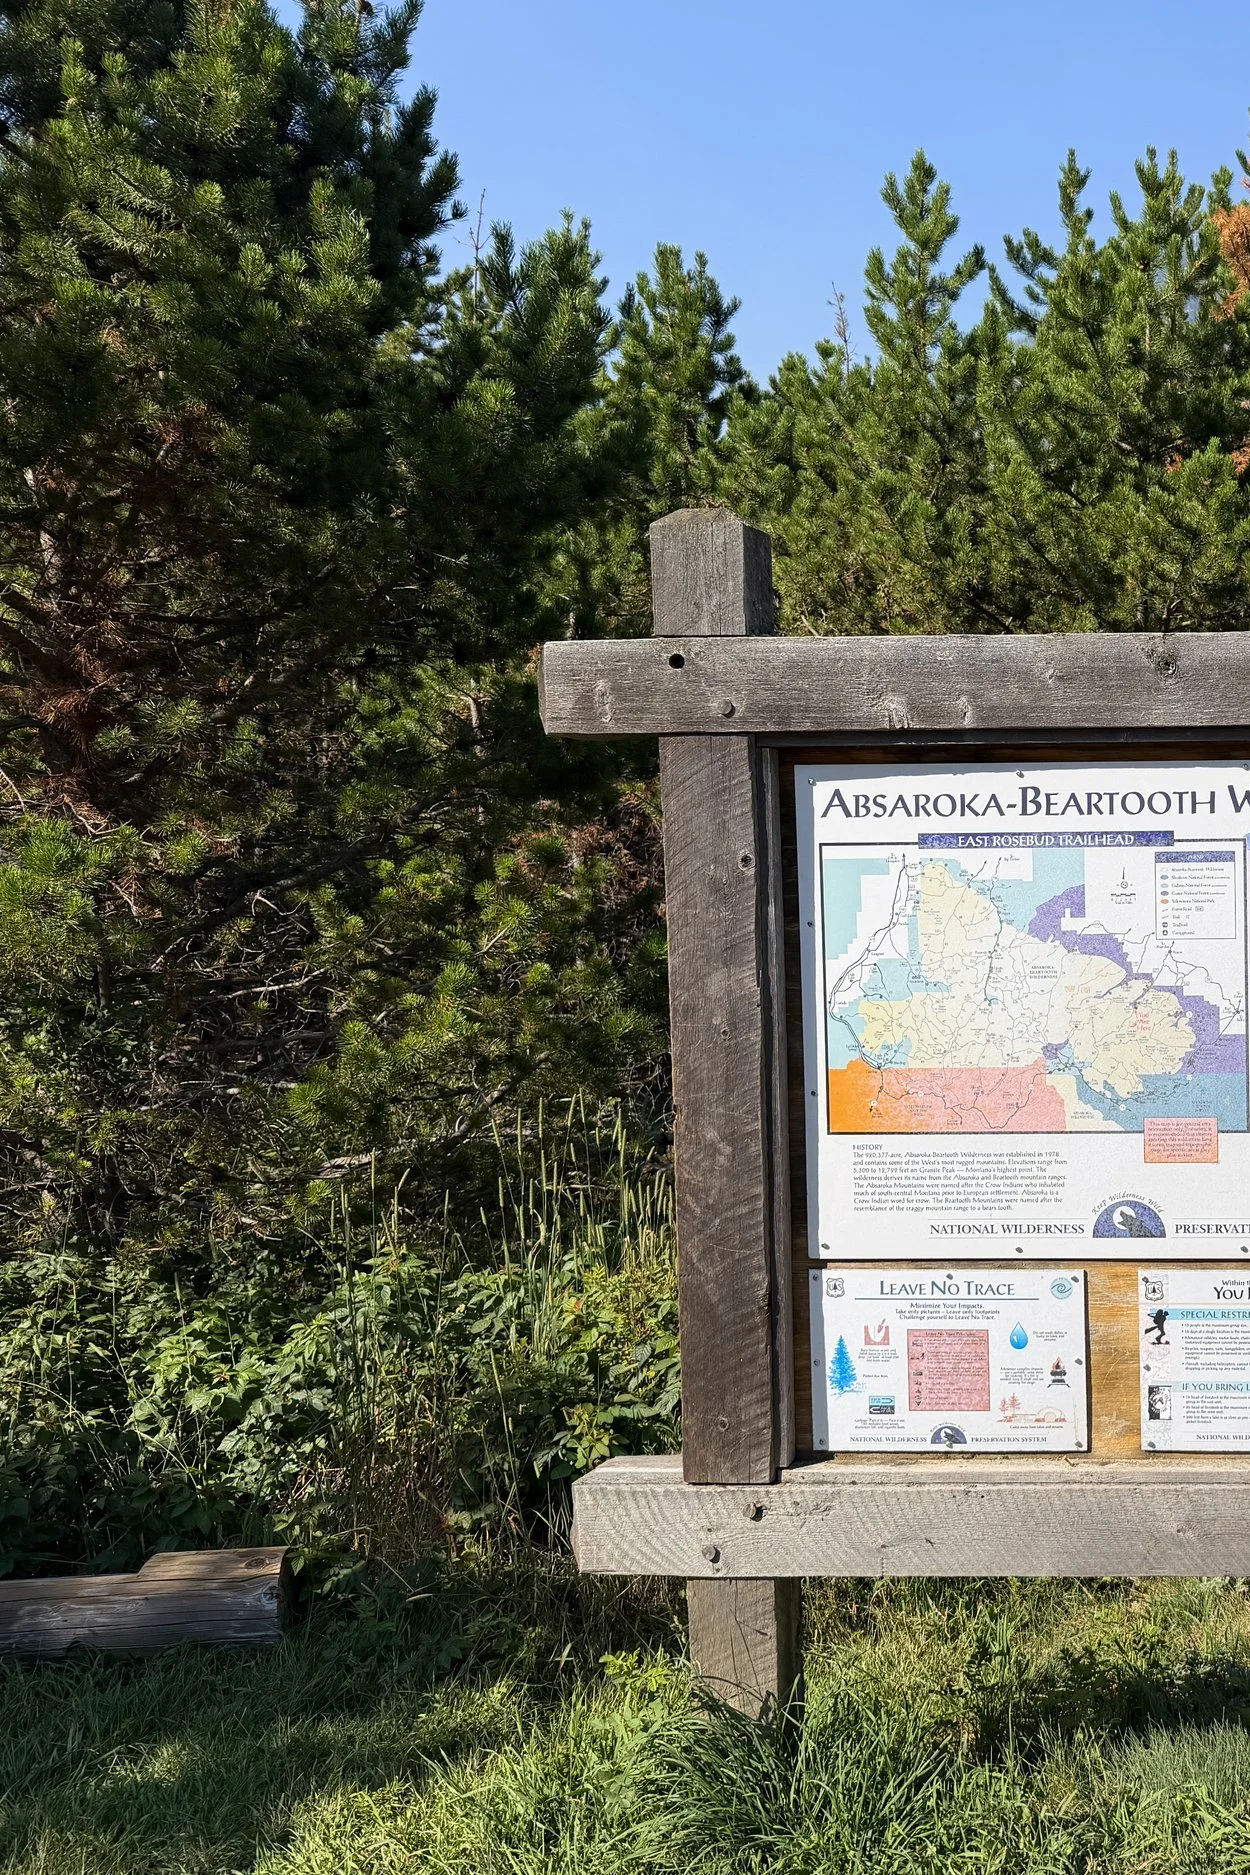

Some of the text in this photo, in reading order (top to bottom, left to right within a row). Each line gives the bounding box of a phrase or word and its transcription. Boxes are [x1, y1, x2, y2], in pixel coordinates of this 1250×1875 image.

[820, 785, 1215, 818] ABSAROKA-BEARTOOTH
[956, 833, 1136, 848] EAST ROSEBUD TRAILHEAD
[1091, 1190, 1165, 1215] Keep Wilderness Wild
[928, 1223, 998, 1239] NATIONAL
[1000, 1223, 1084, 1238] WILDERNESS
[879, 1280, 1014, 1295] LEAVE NO TRACE
[1221, 1279, 1245, 1288] Within
[1213, 1286, 1244, 1299] YOU
[895, 1308, 906, 1316] Take
[907, 1308, 919, 1316] only
[961, 1308, 973, 1316] only
[909, 1302, 941, 1310] Minimize
[958, 1302, 984, 1310] Impacts.
[1180, 1310, 1218, 1319] SPECIAL
[1182, 1382, 1189, 1390] IF
[1191, 1382, 1213, 1391] YOU
[1215, 1383, 1243, 1392] BRING
